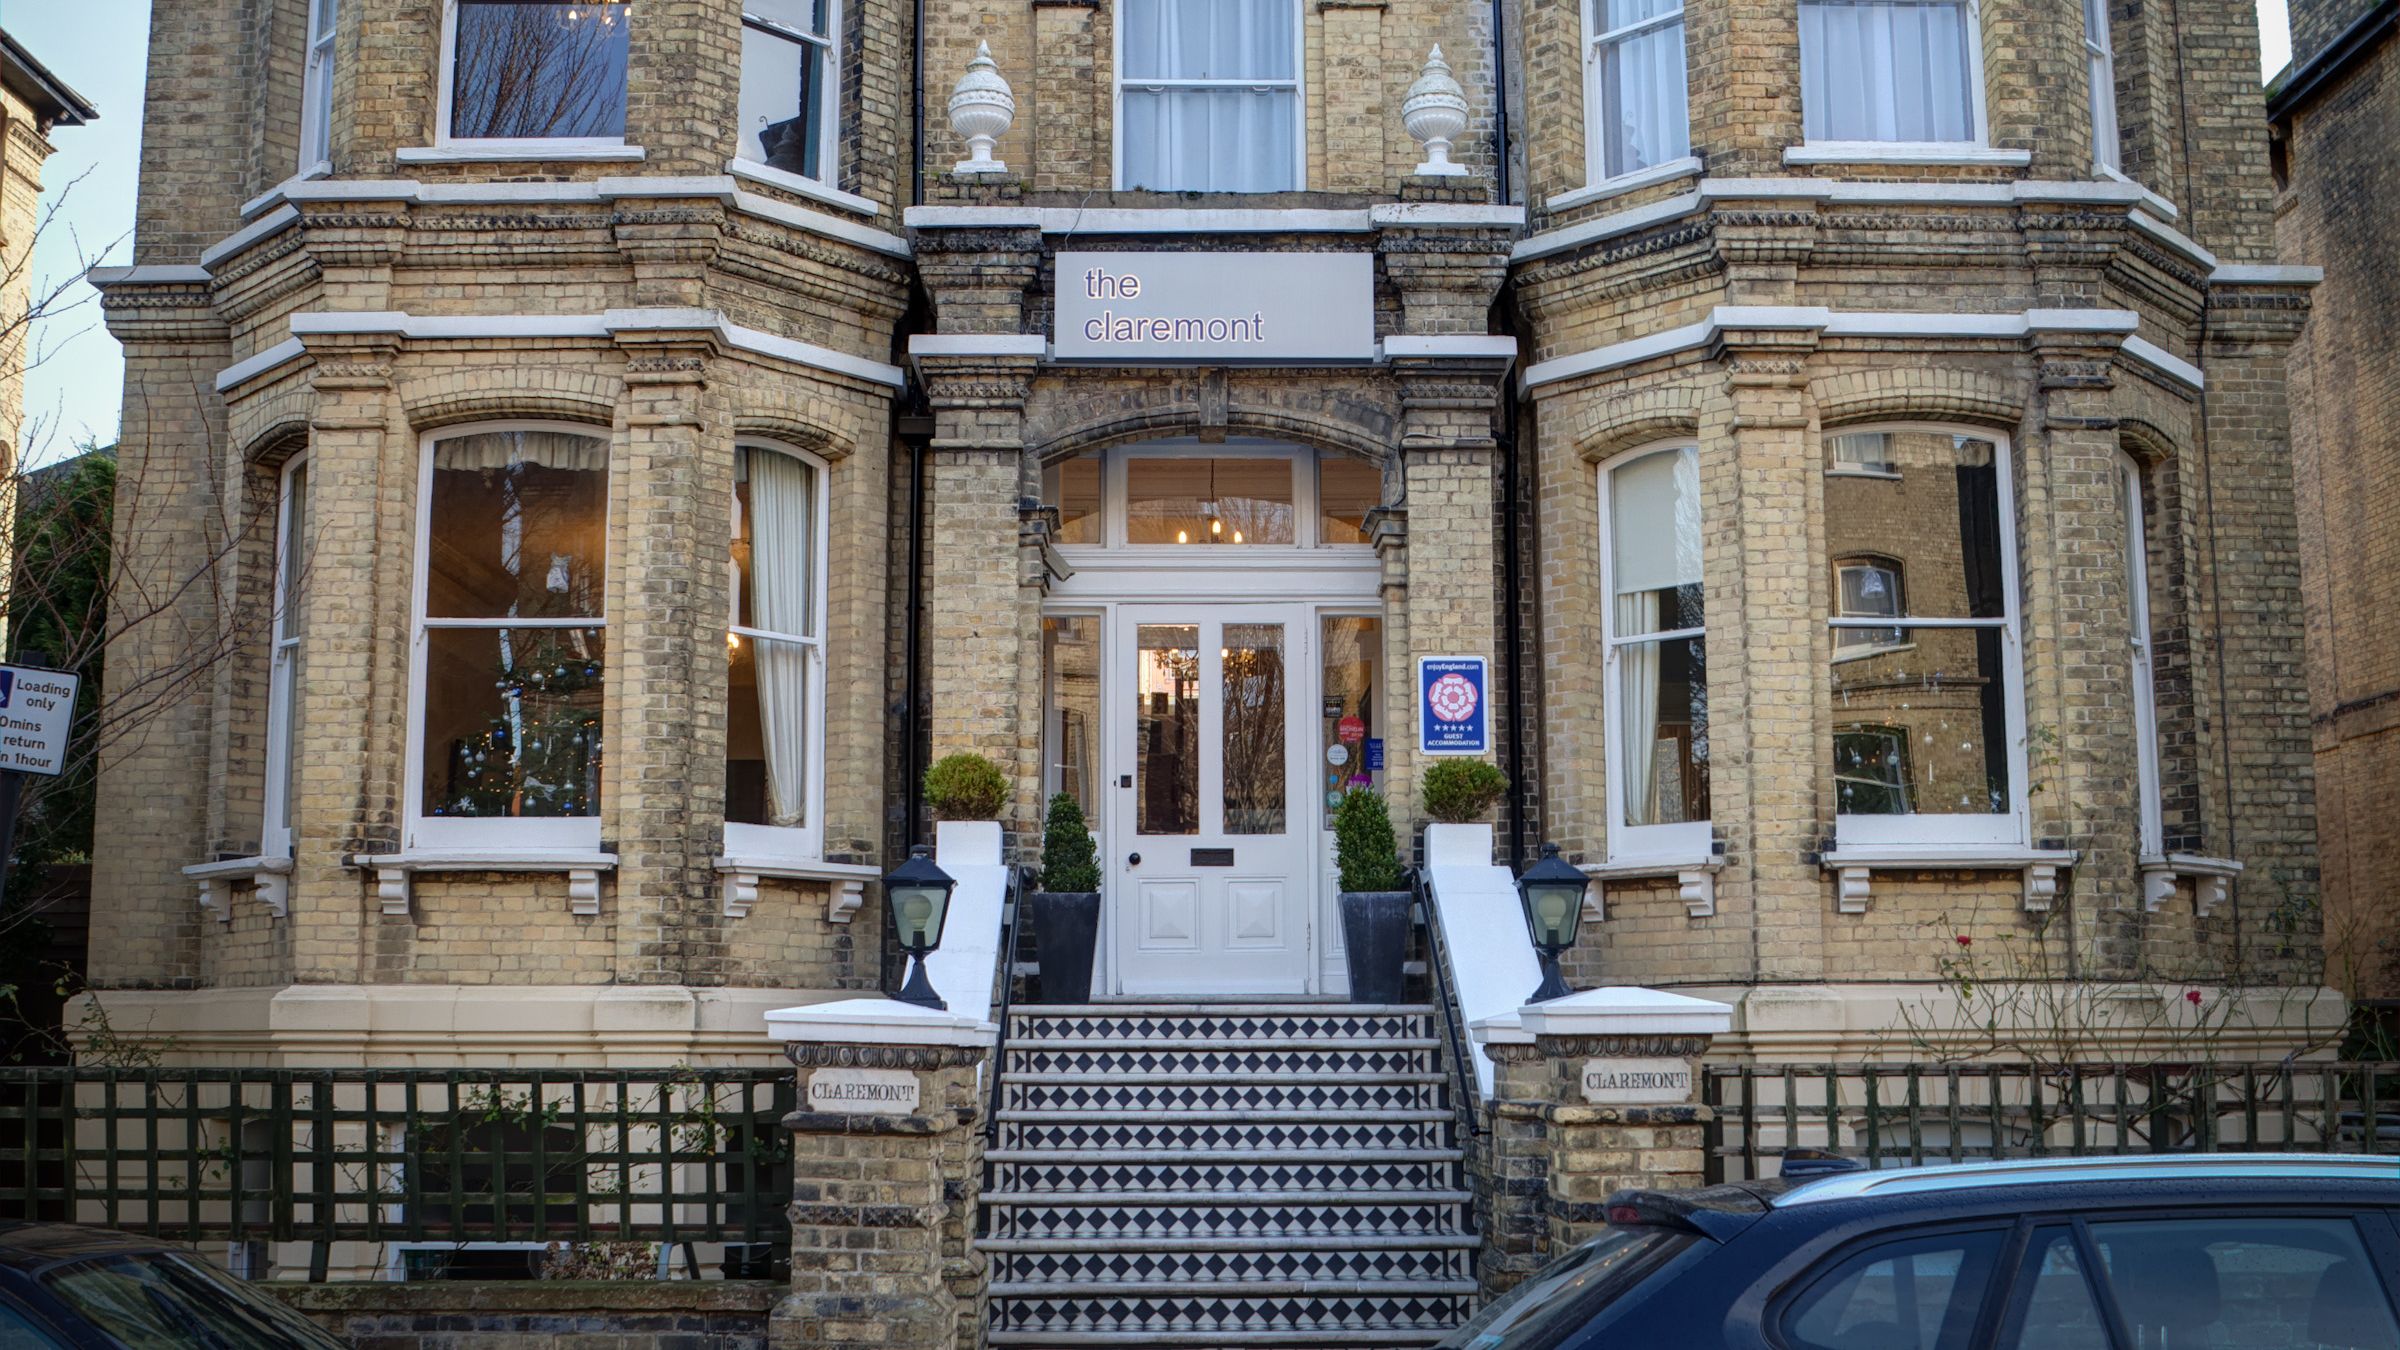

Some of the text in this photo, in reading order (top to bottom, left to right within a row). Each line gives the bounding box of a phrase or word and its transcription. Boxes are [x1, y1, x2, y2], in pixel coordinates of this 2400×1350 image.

[1084, 268, 1141, 299] the
[1084, 311, 1265, 342] claremont
[1426, 663, 1479, 671] enjoyEngland.com
[17, 678, 70, 697] Loading
[26, 697, 56, 711] only
[0, 715, 41, 731] 0mins
[3, 735, 46, 750] return
[1586, 1072, 1687, 1090] CLAREMONT
[812, 1083, 914, 1101] CLAREMONT
